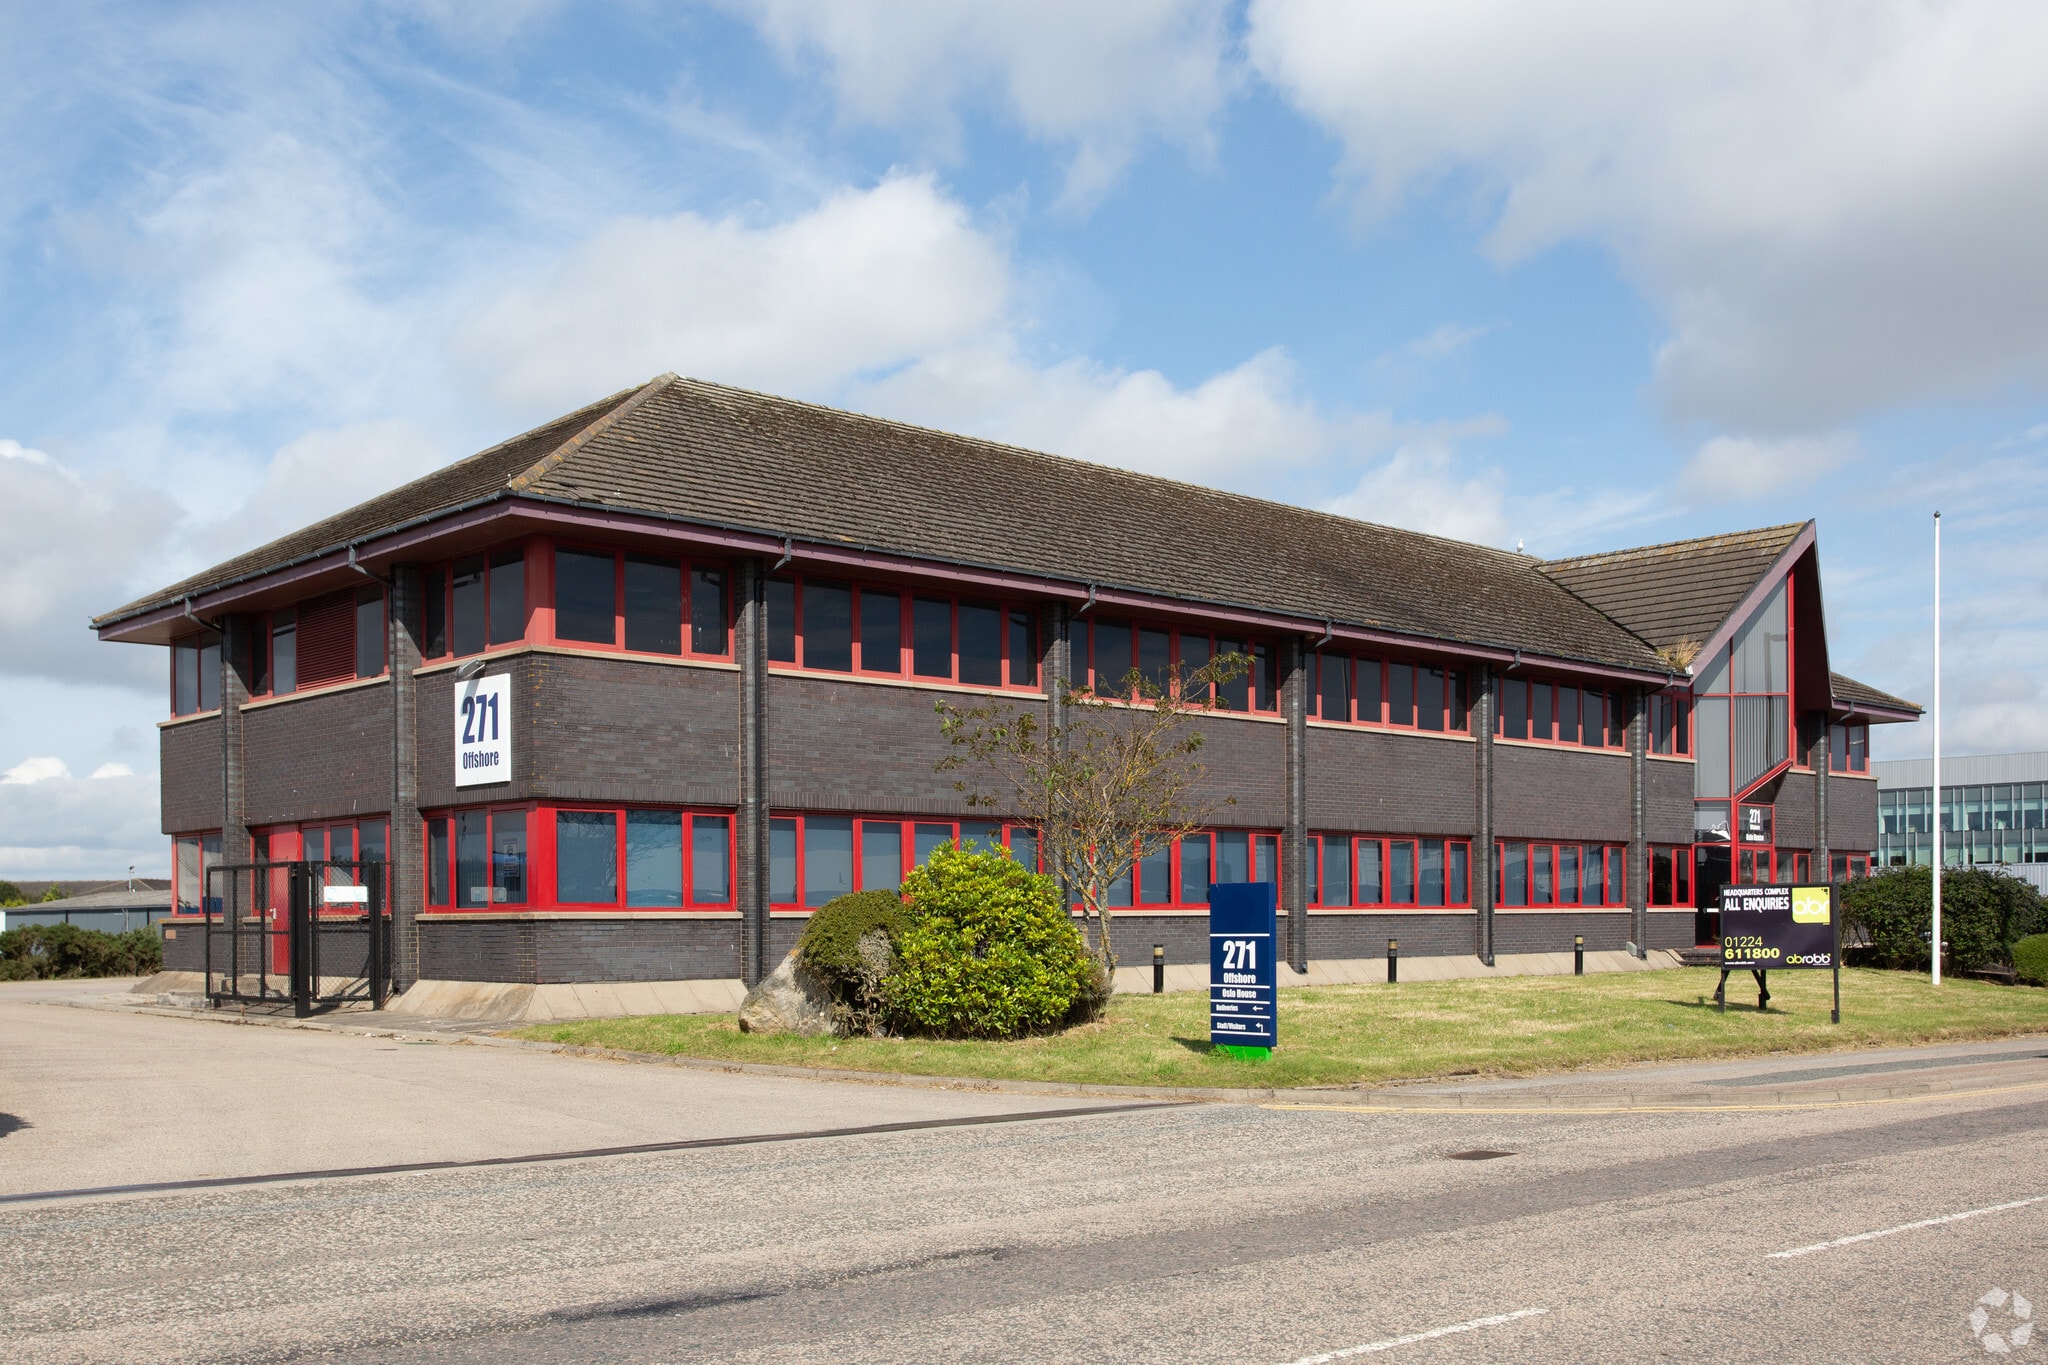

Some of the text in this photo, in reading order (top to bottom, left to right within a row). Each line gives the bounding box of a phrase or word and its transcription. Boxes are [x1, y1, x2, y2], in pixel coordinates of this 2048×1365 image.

[462, 692, 498, 744] 271
[462, 751, 499, 769] Offshore
[1750, 809, 1760, 823] 271
[1724, 888, 1763, 896] HEADQUARTERS
[1724, 897, 1789, 912] ALL ENQUIRIES
[1724, 936, 1763, 948] 01224
[1223, 941, 1255, 969] 271
[1725, 948, 1780, 959] 611800
[1786, 953, 1830, 964] abrobb
[1223, 973, 1256, 984] Offshore
[1222, 989, 1256, 998] Oslo House
